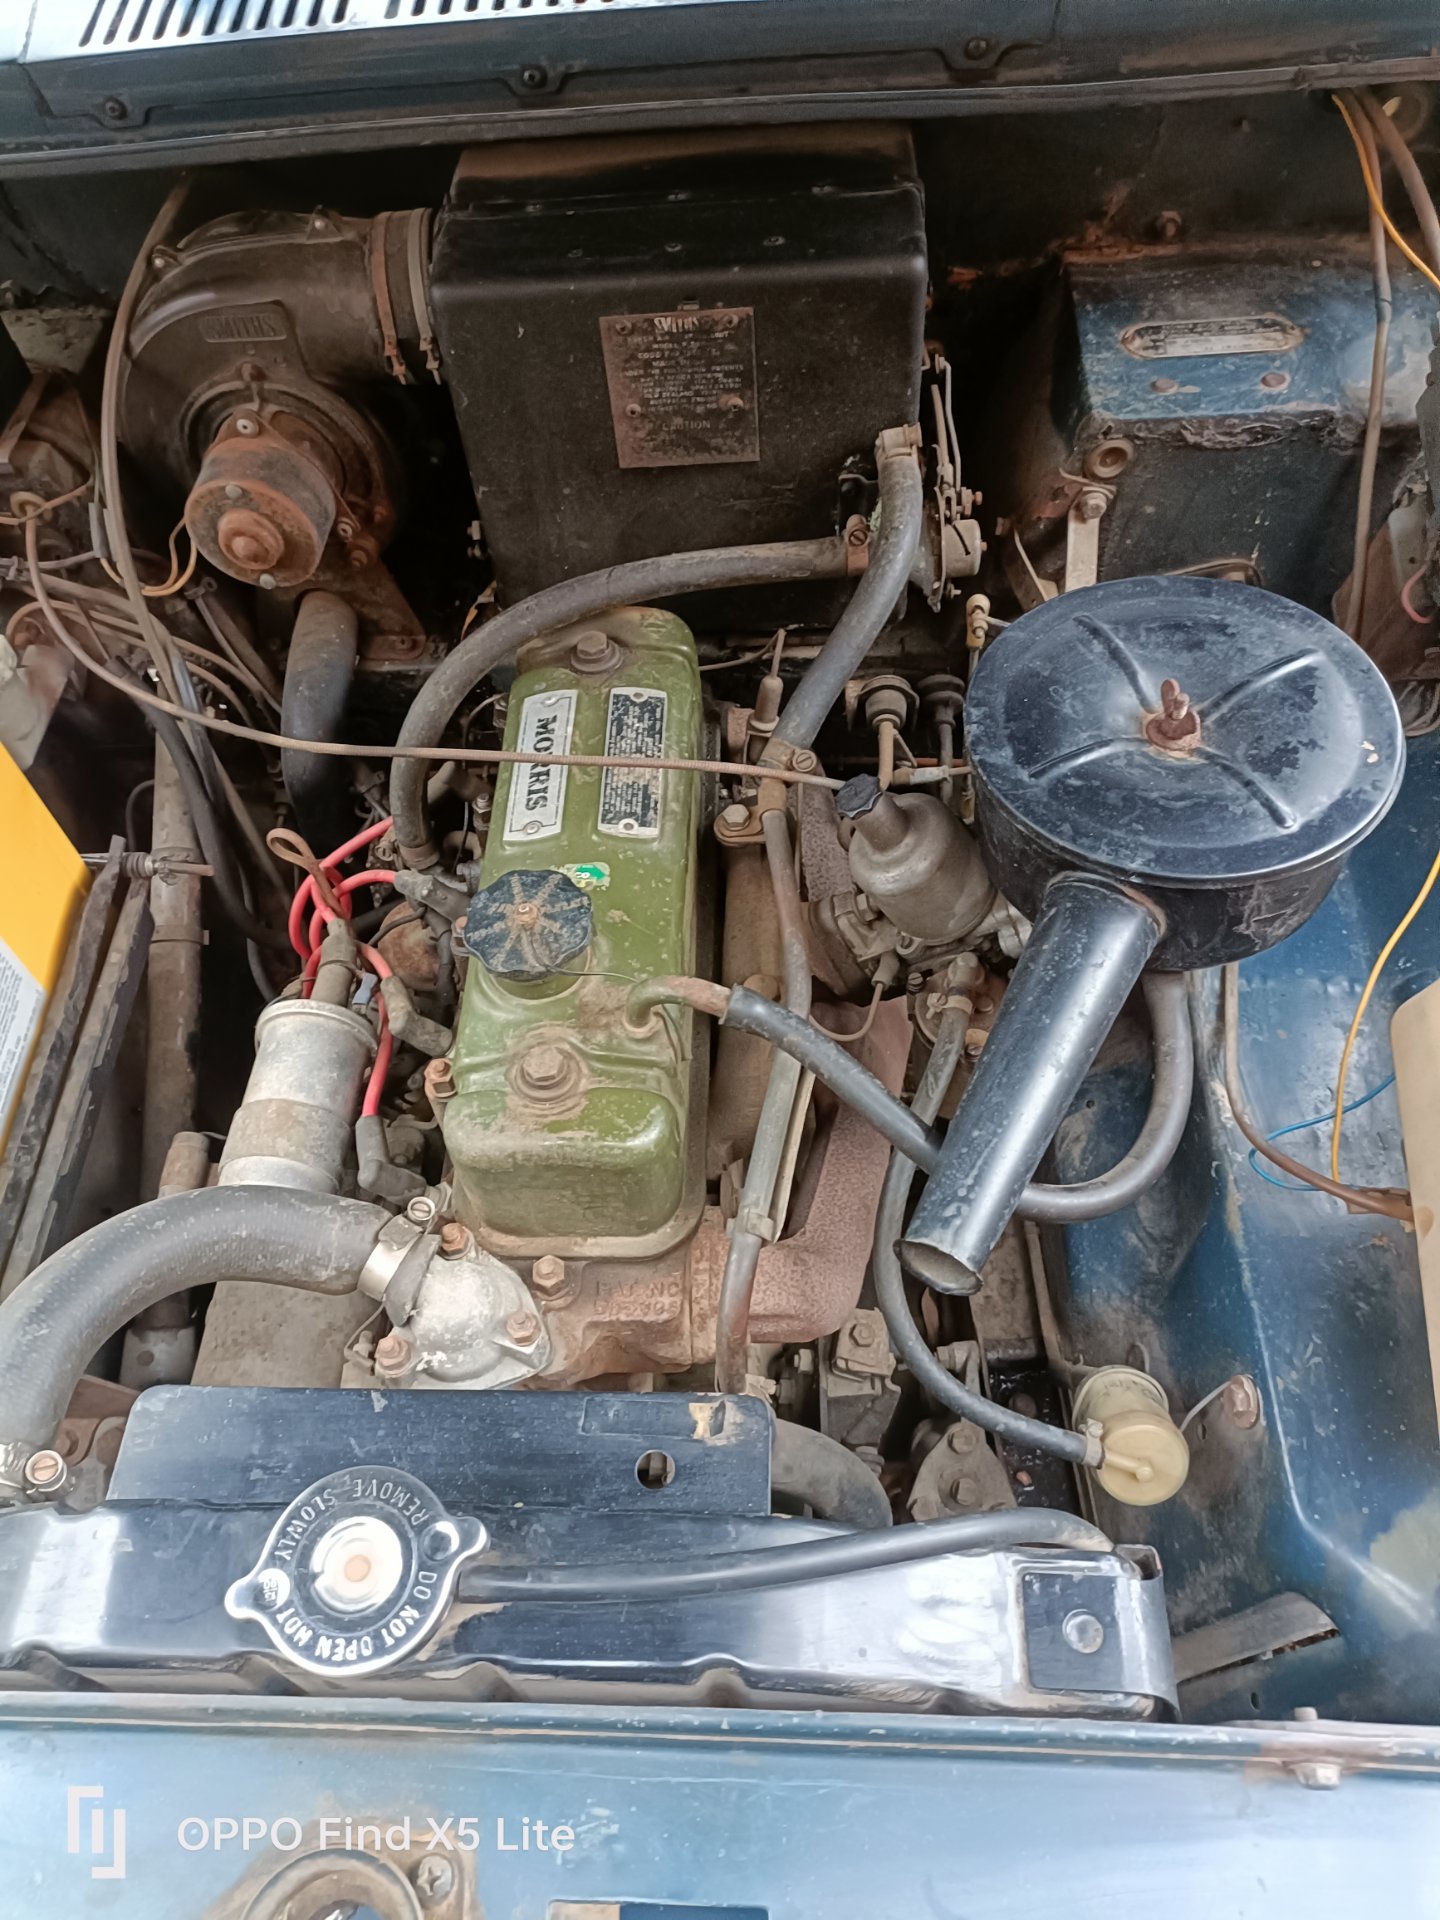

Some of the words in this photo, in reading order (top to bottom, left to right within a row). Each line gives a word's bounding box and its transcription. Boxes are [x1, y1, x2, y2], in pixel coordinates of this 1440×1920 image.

[210, 316, 276, 339] SMITHS
[662, 420, 711, 430] CAUTION
[352, 1478, 431, 1526] REMOVE
[274, 1488, 337, 1561] SLOWLY
[413, 1571, 438, 1600] DO
[276, 1607, 314, 1648] HOT
[381, 1604, 421, 1648] NOT
[314, 1635, 374, 1662] OPEN
